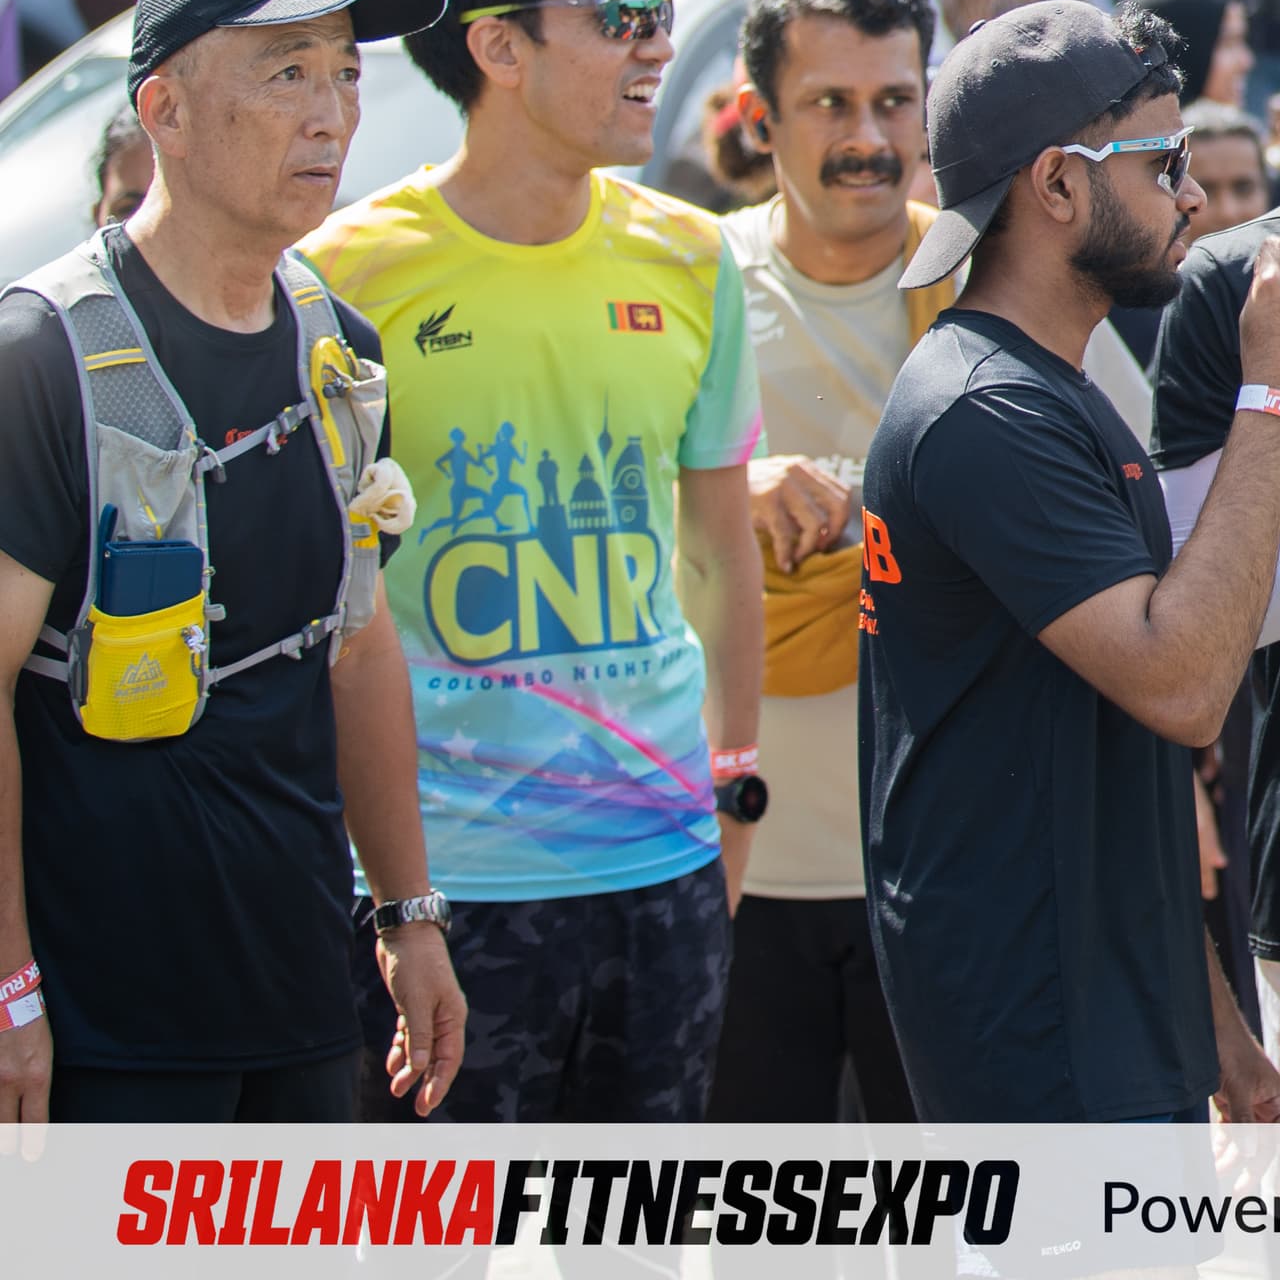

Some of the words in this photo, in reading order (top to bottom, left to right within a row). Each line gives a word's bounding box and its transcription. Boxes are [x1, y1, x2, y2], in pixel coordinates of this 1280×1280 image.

[429, 531, 661, 662] CNR
[428, 670, 553, 691] COLOMBO
[573, 659, 651, 681] NIGHT
